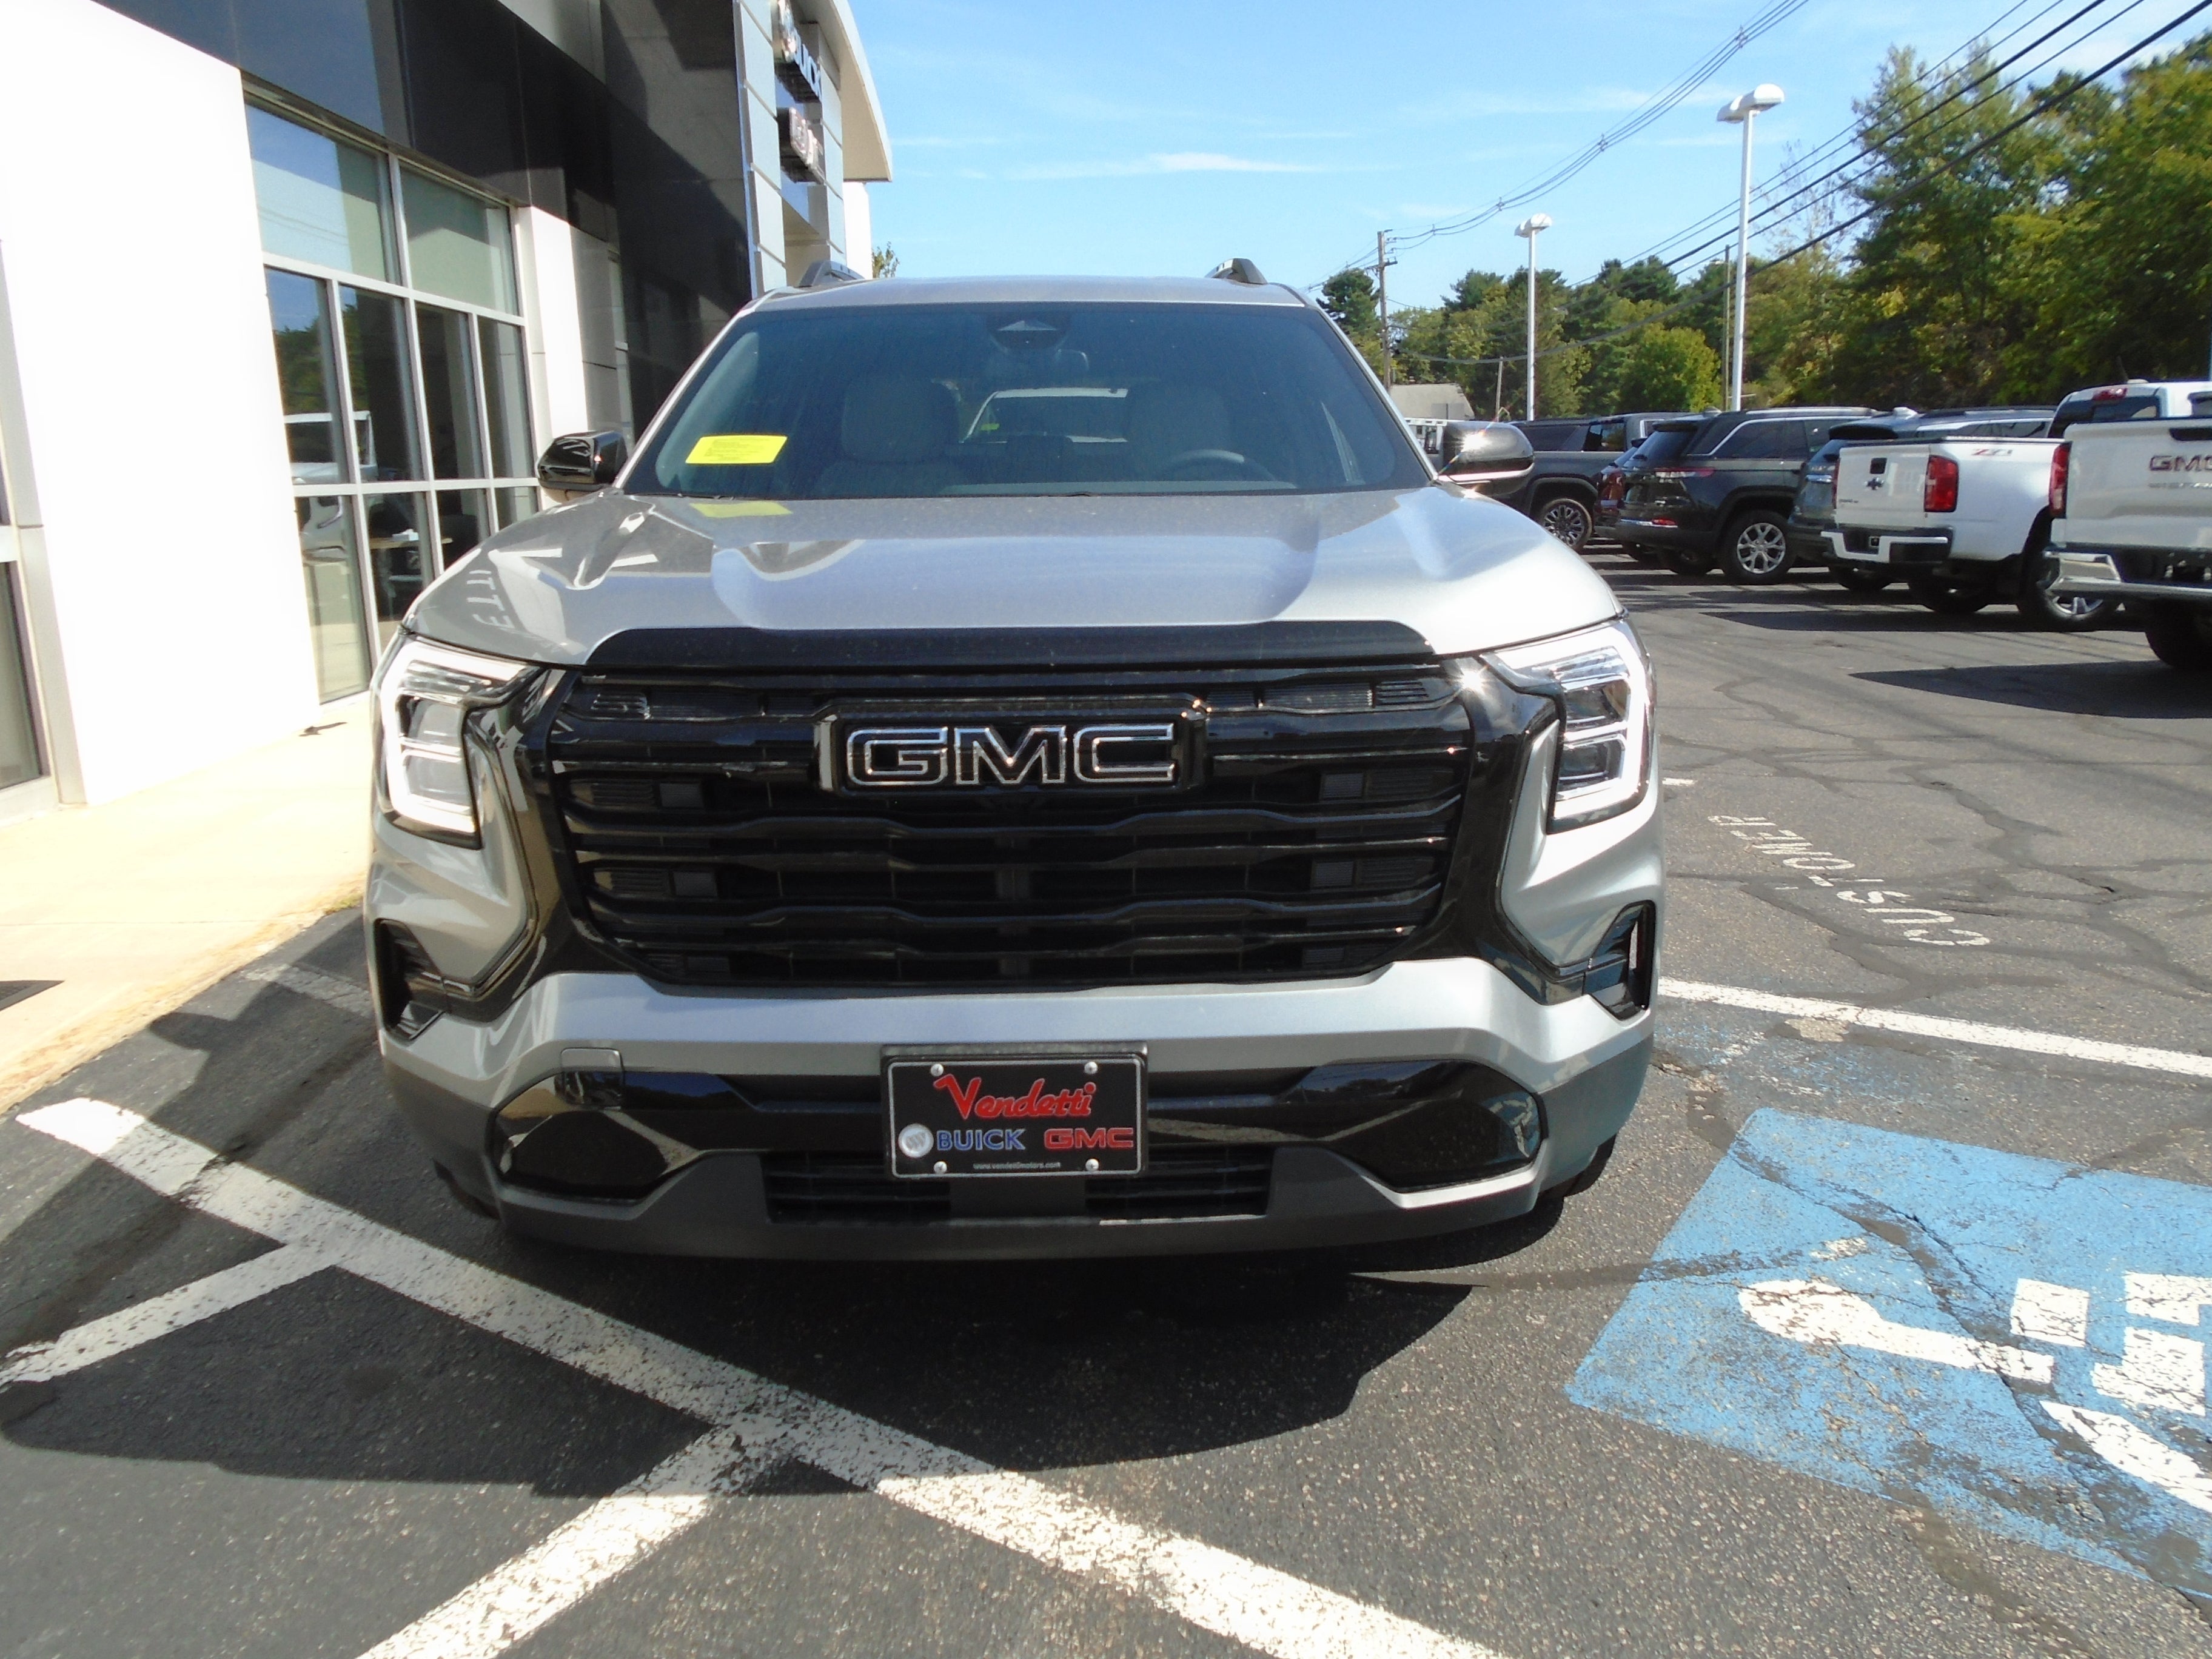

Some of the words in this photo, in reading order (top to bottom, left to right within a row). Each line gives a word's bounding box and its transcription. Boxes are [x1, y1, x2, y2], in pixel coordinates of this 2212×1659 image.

[847, 724, 1175, 786] GMC
[1708, 815, 1991, 946] CUSTOMER
[933, 1074, 1096, 1120] Vendetti
[937, 1129, 1025, 1151] BUICK
[1044, 1127, 1133, 1149] GMC
